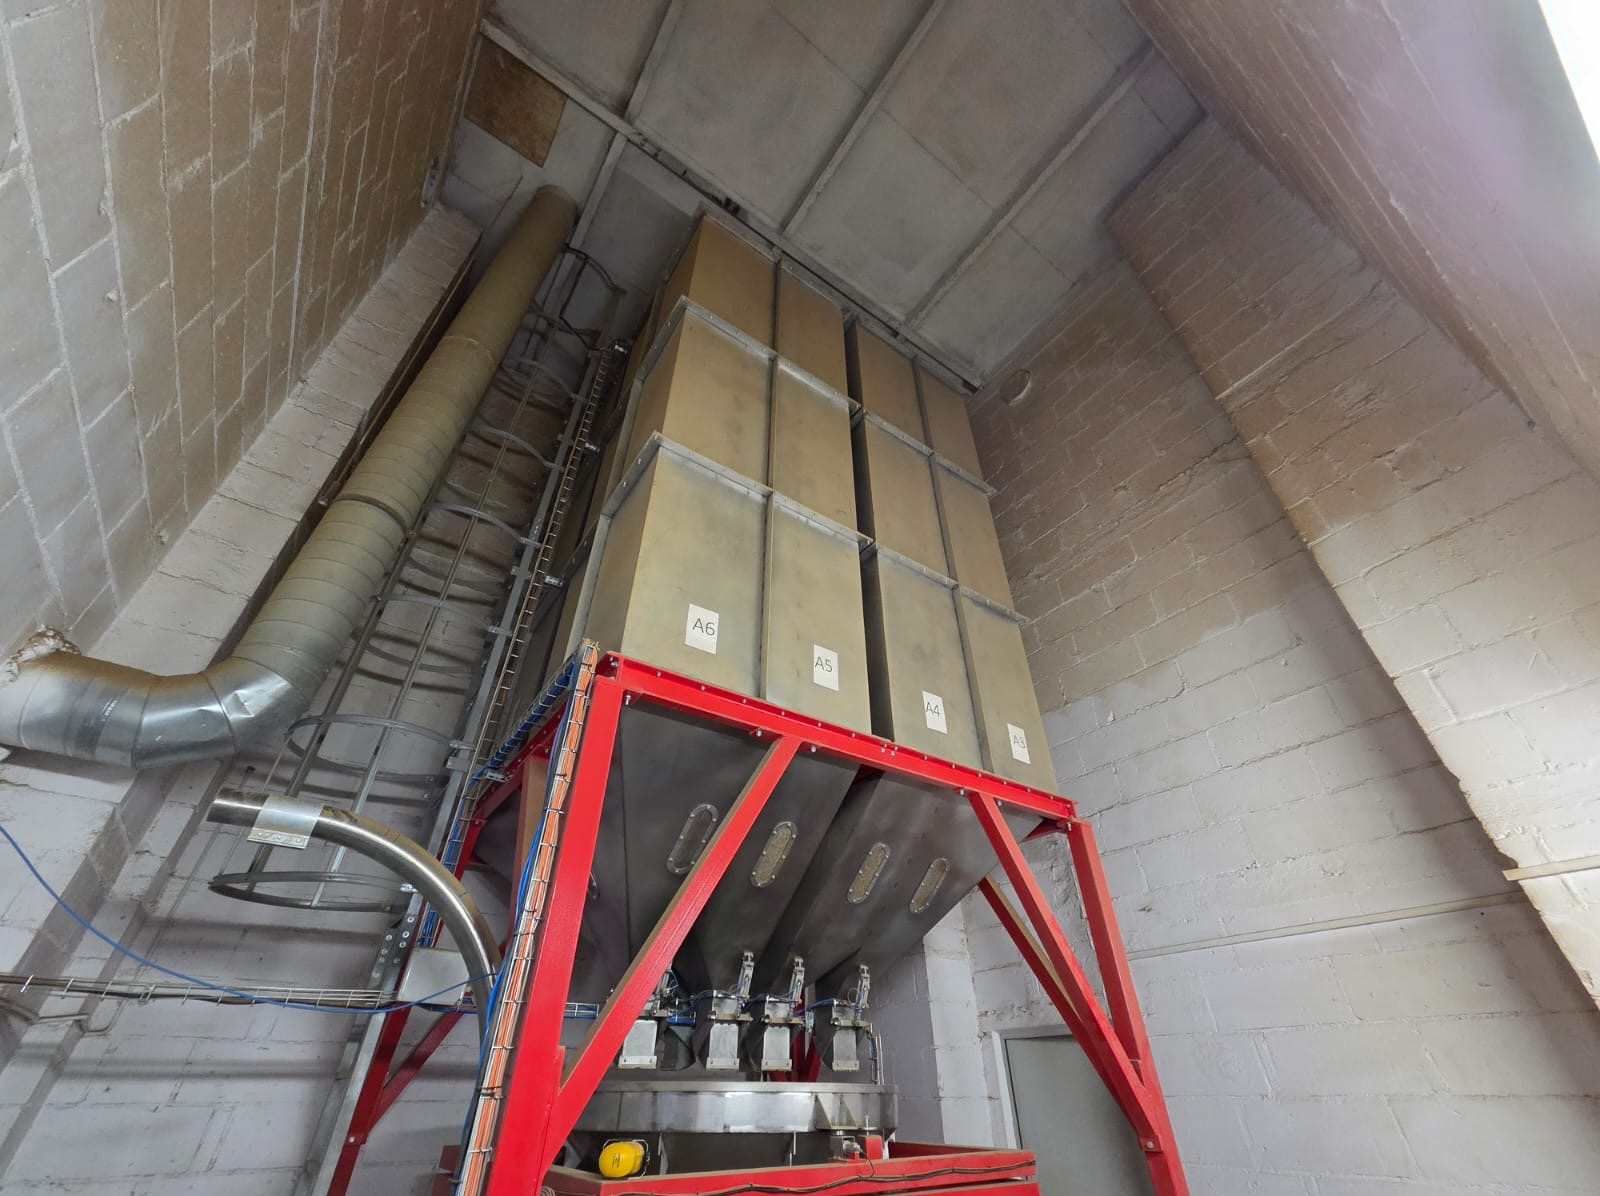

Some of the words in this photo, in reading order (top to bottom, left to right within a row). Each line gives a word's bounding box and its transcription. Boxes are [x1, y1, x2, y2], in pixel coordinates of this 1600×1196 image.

[692, 617, 716, 636] A6
[814, 656, 833, 673] A5
[925, 701, 940, 717] A4
[1013, 735, 1026, 749] A3
